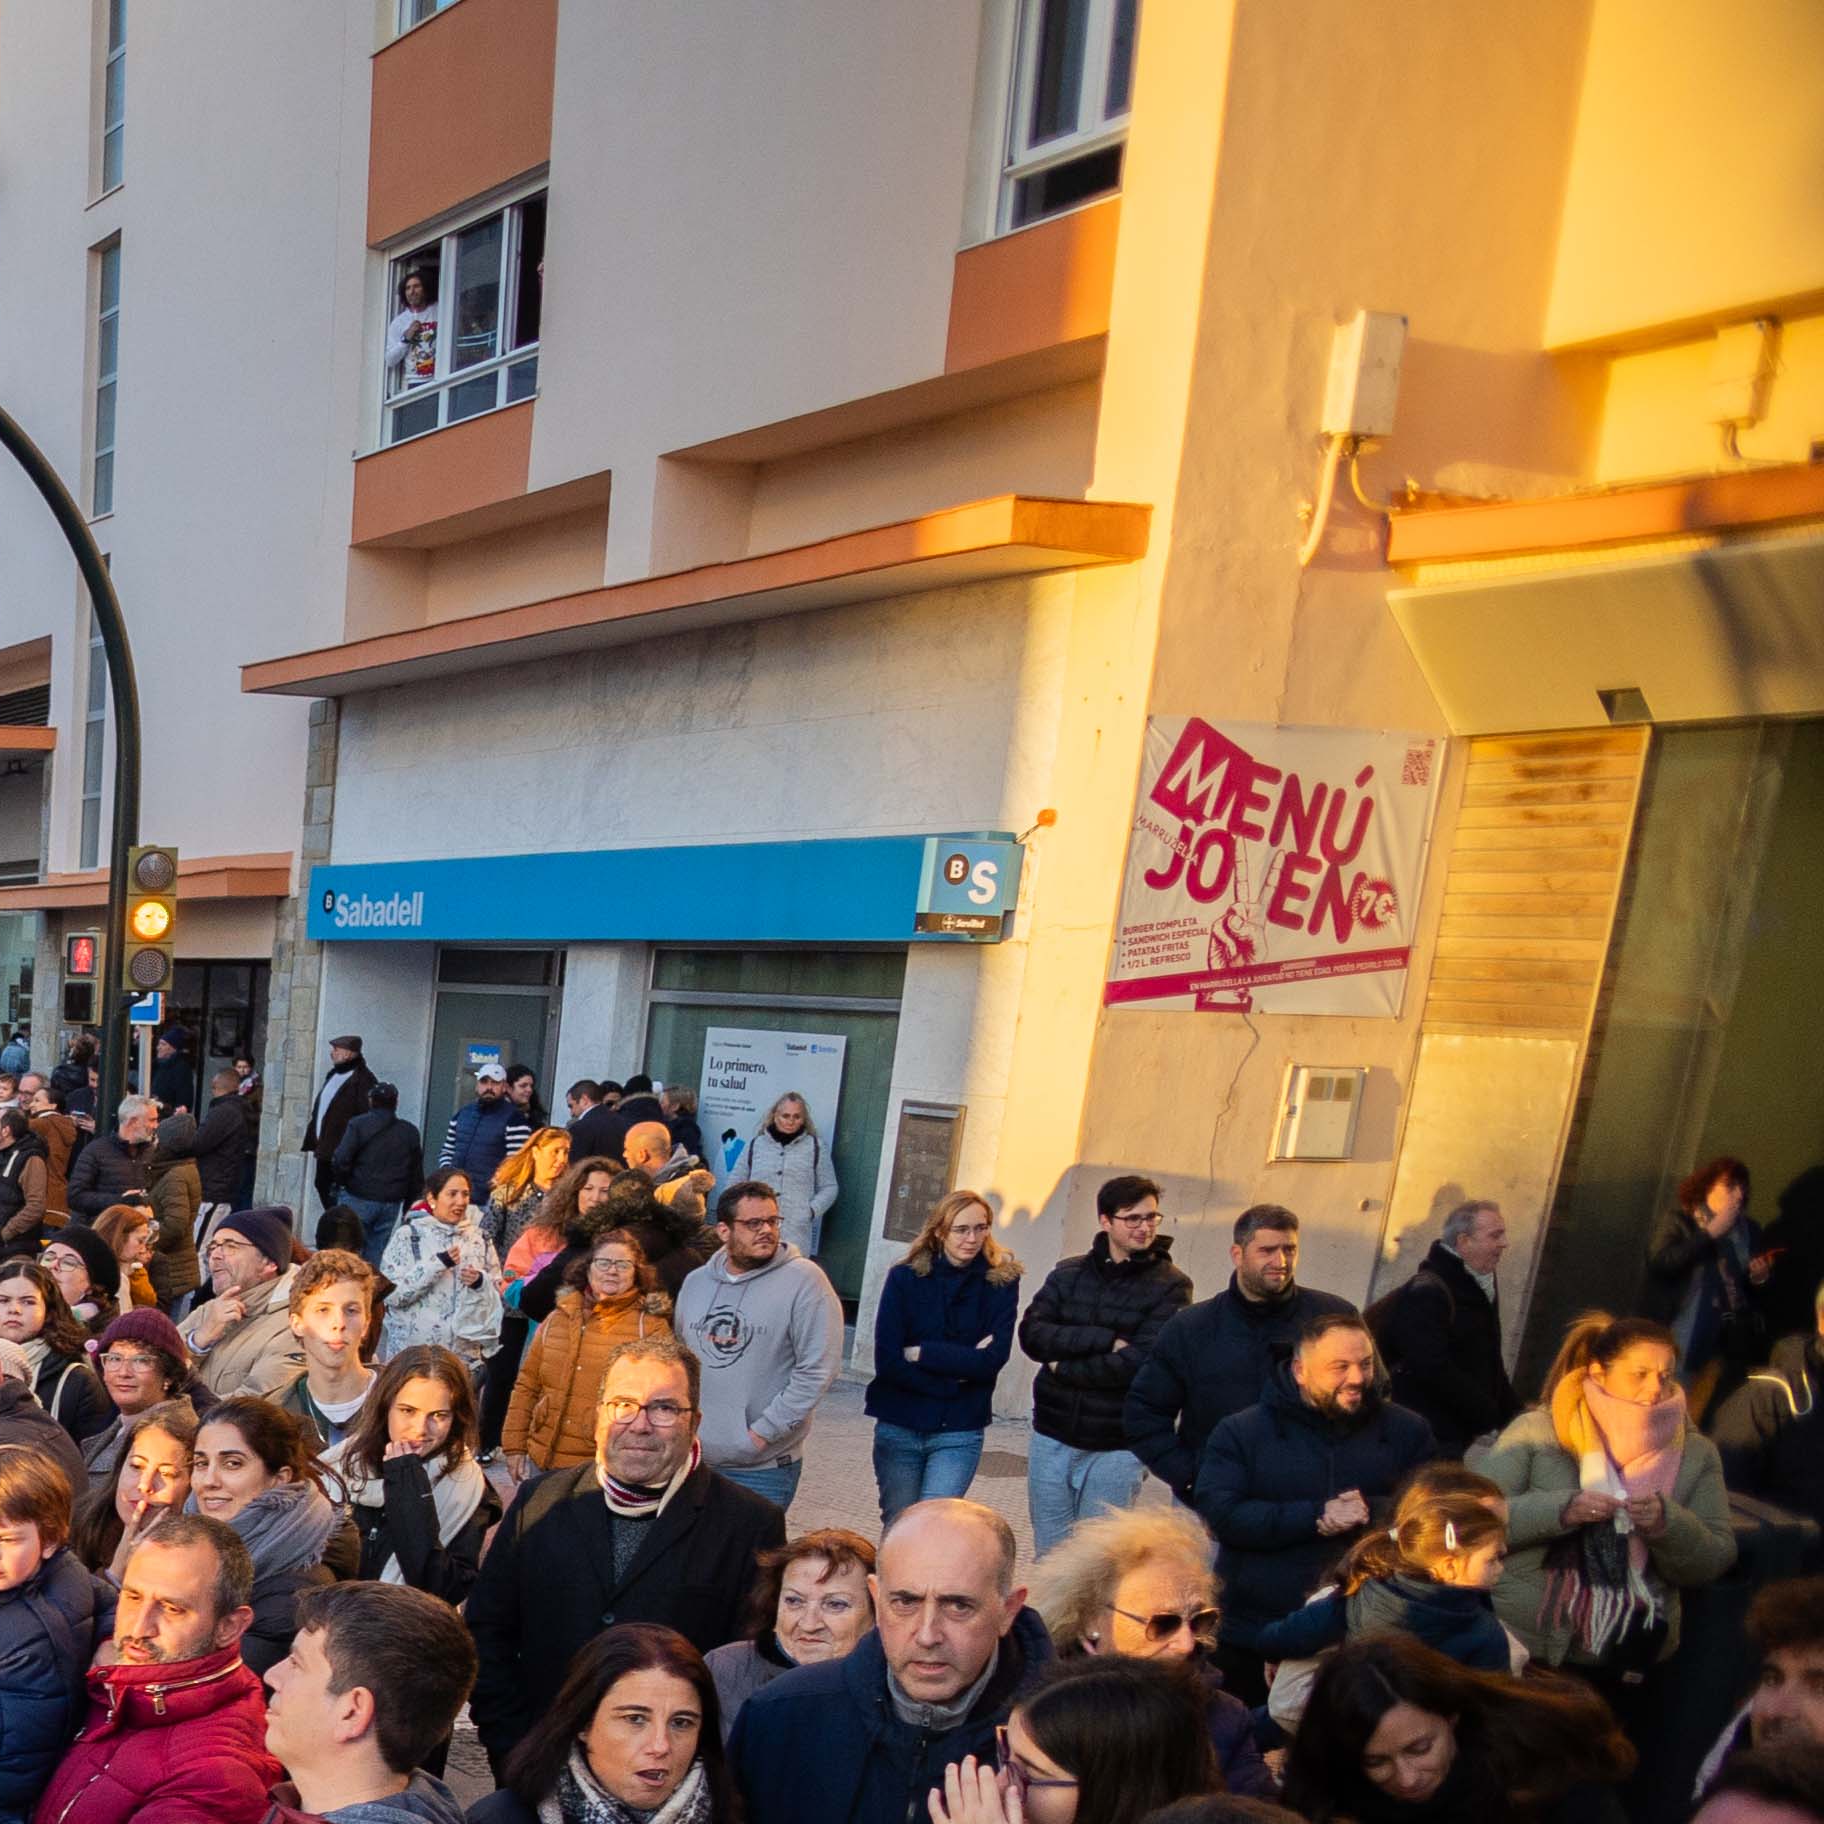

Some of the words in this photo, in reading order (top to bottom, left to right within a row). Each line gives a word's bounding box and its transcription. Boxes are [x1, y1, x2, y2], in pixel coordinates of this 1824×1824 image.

[1166, 738, 1374, 867] MENÚ
[1136, 815, 1199, 867] MARRUZELLA
[334, 891, 424, 928] Sabadell
[1122, 923, 1154, 936] BURGER
[1155, 917, 1198, 931] COMPLETA
[1128, 933, 1170, 946] SANDWICH
[1172, 928, 1209, 940] ESPECIAL
[1128, 945, 1160, 957] PATATAS
[1161, 941, 1190, 952] FRITAS
[1150, 953, 1191, 965] REFRESCO
[710, 1056, 723, 1070] Lo
[724, 1058, 768, 1075] primero,
[707, 1077, 718, 1088] tu
[720, 1077, 747, 1091] salud
